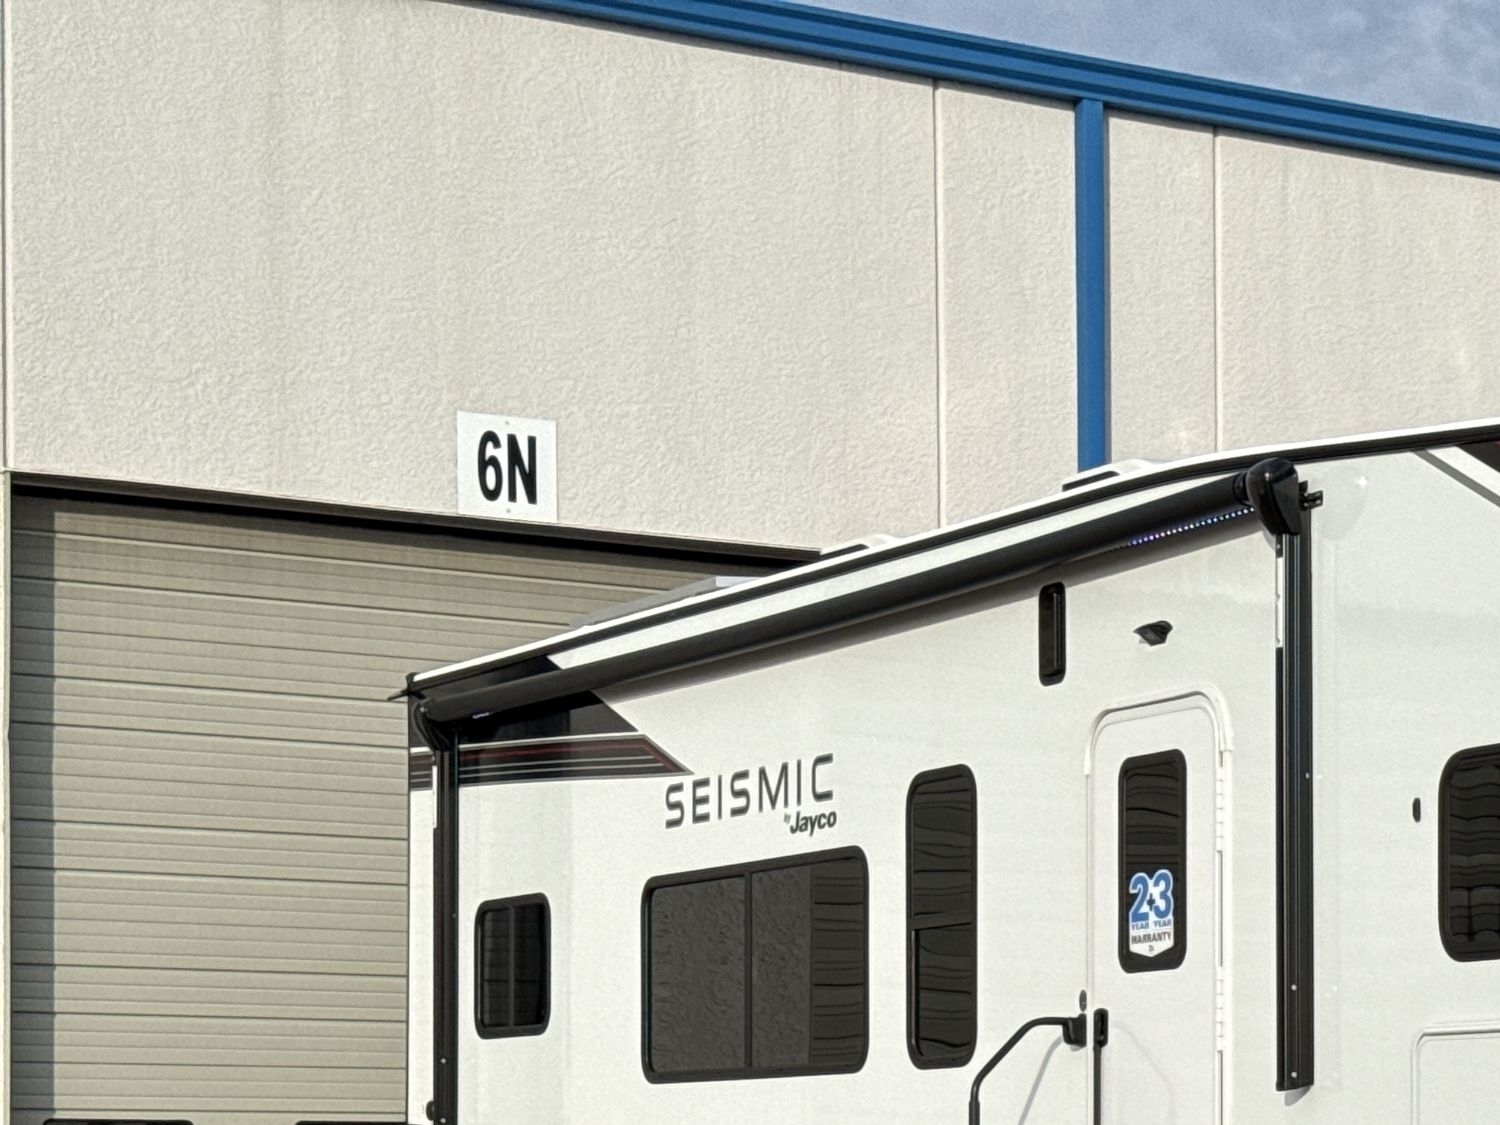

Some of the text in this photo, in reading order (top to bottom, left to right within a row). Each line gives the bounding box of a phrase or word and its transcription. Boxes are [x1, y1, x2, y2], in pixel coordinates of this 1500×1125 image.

[477, 430, 538, 505] 6N
[665, 752, 834, 830] SEISMIC
[789, 810, 838, 838] Jayco
[1131, 931, 1171, 945] WARRANTY
